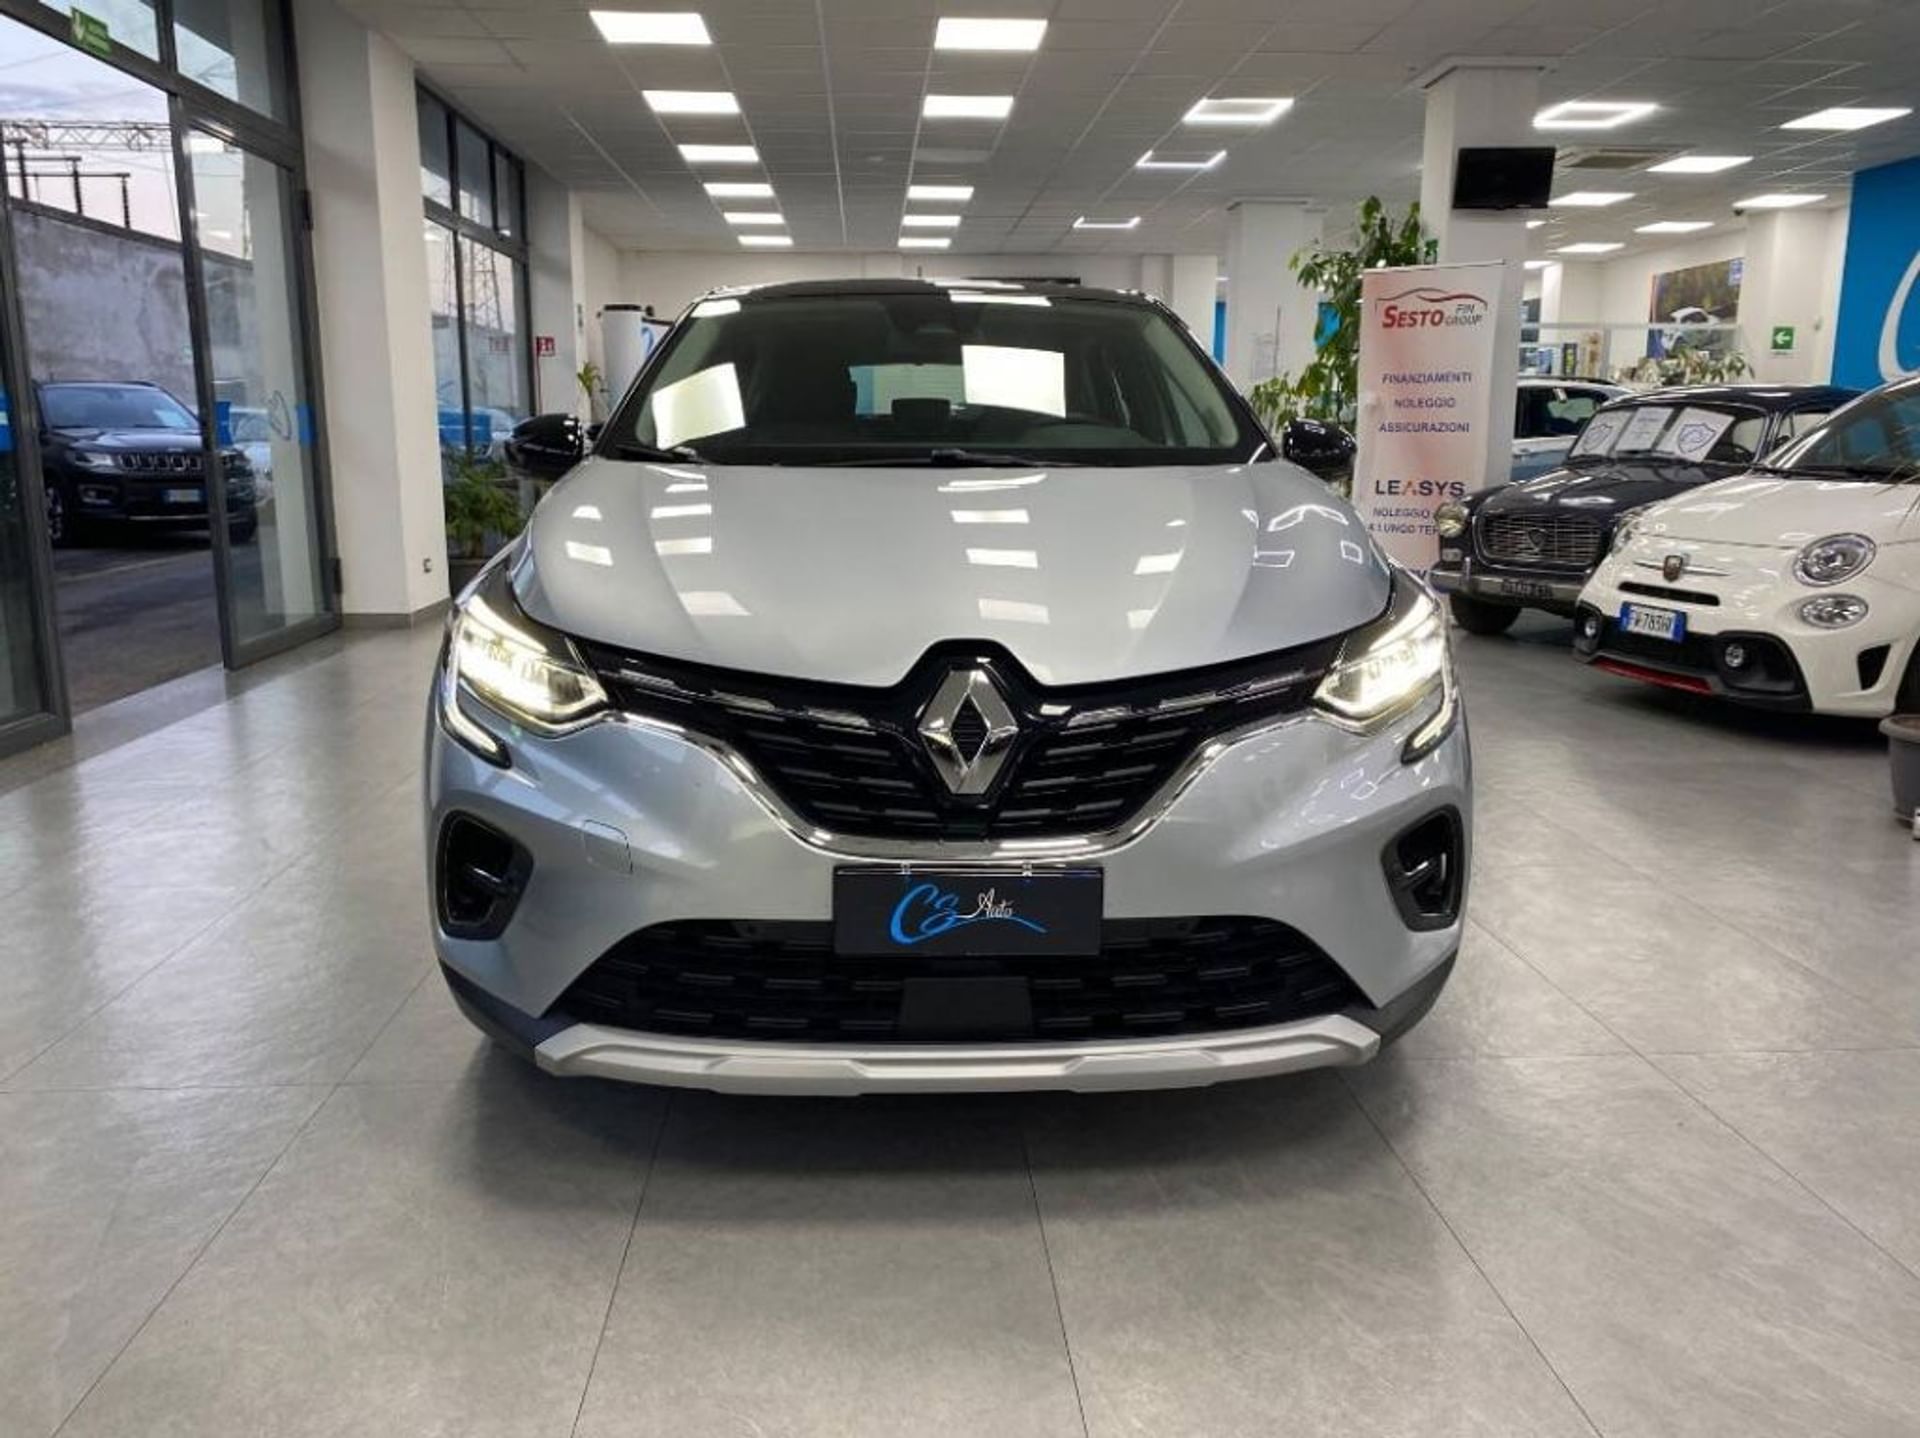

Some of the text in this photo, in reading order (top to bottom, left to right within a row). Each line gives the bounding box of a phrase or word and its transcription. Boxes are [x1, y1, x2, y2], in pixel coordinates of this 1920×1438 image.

[1382, 305, 1444, 328] SESTO
[1382, 371, 1472, 384] FINANZIAMENTI
[1394, 397, 1456, 408] NOLEGGIO
[1379, 422, 1470, 433] ASSICURAZIONI
[1375, 479, 1465, 497] LEASYS
[1373, 508, 1430, 519] NOLEGGIO
[968, 888, 1017, 918] Auto
